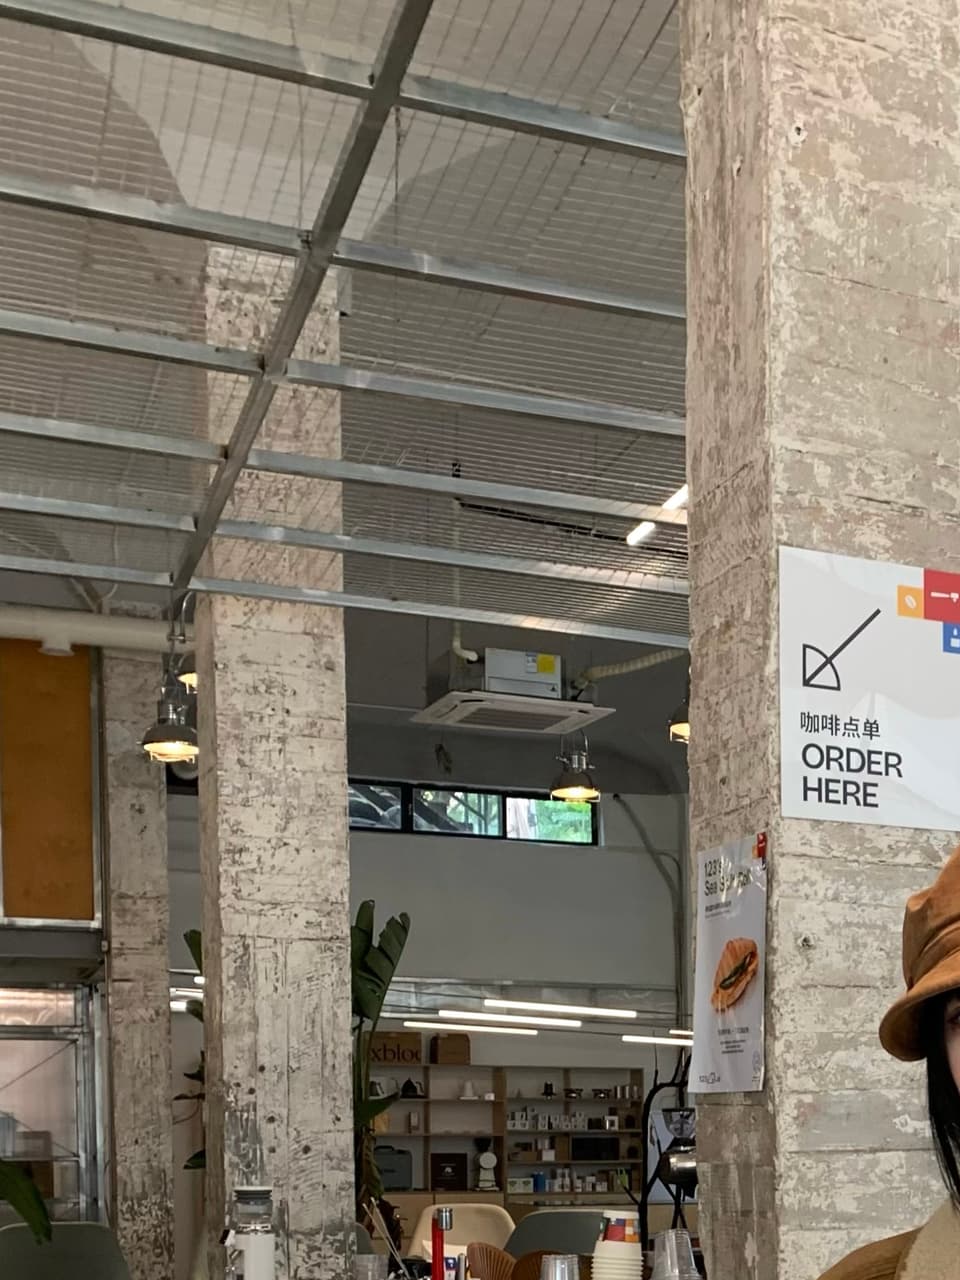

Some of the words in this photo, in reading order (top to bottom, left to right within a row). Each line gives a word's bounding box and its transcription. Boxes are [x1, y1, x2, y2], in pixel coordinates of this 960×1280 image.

[799, 711, 881, 741] 咖啡点单
[801, 743, 903, 778] ORDER
[802, 776, 879, 808] HERE
